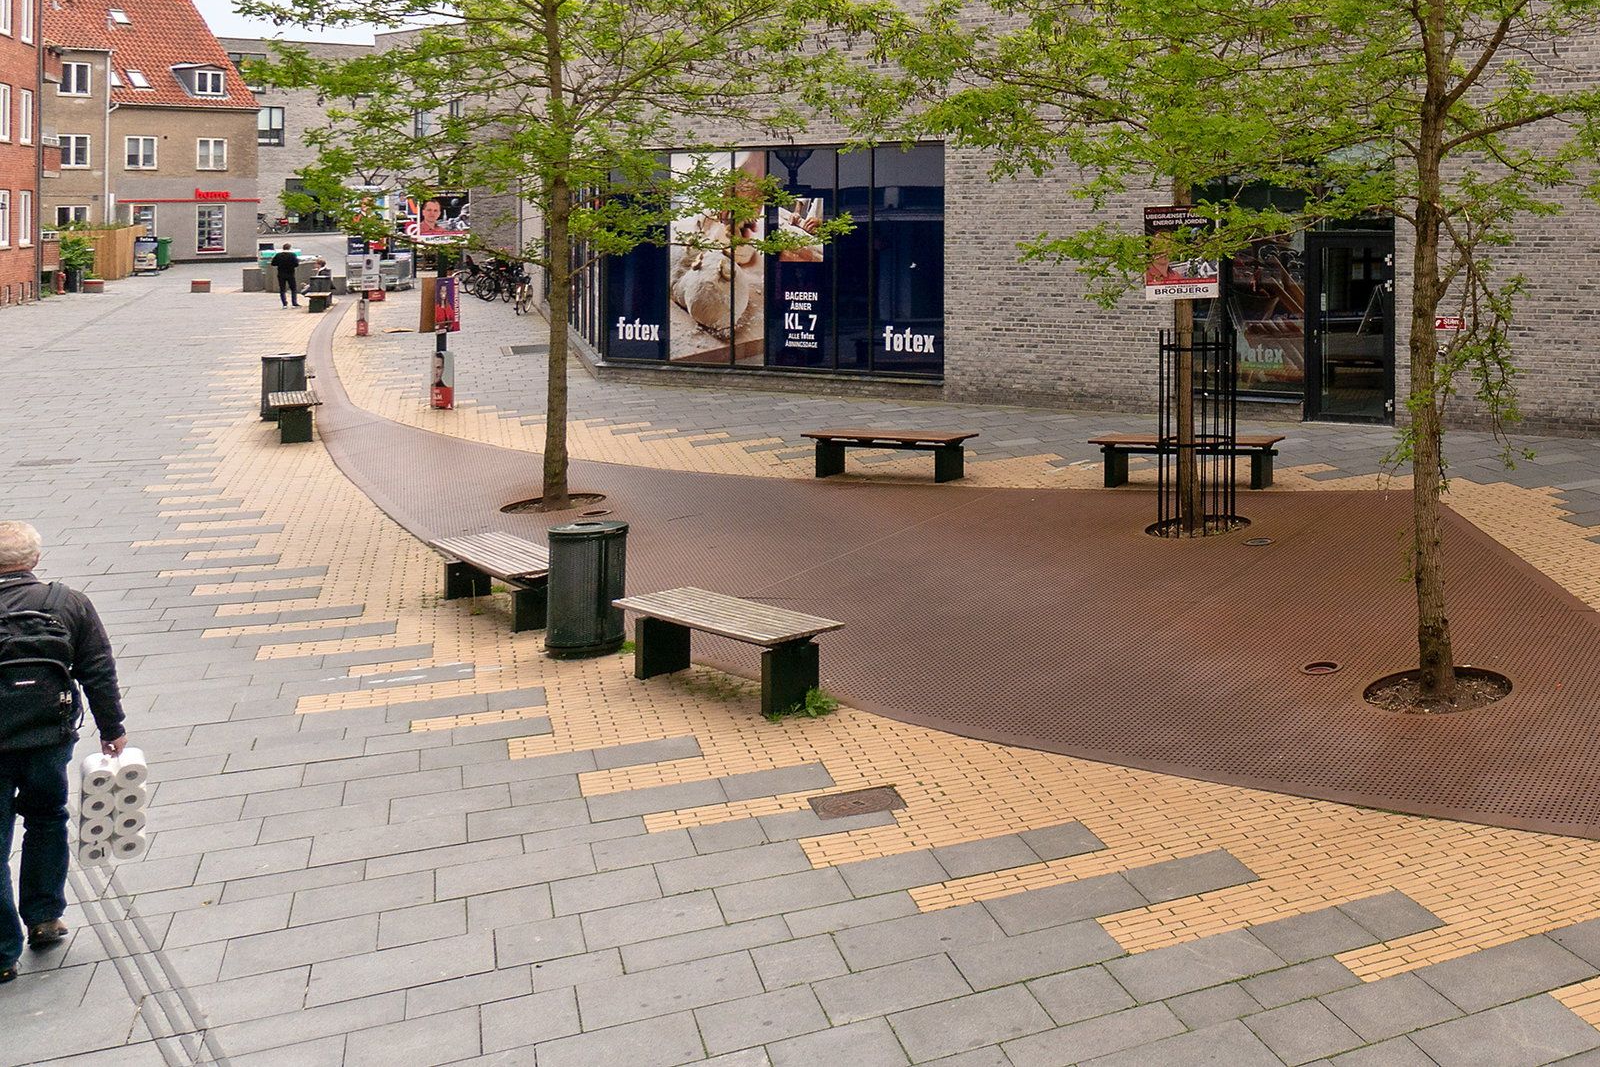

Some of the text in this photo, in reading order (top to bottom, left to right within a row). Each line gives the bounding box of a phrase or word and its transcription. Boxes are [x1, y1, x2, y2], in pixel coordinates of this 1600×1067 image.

[784, 291, 818, 301] BAGEREN
[1154, 286, 1209, 295] BROBJERG
[790, 300, 812, 311] ÅBNER
[616, 316, 660, 341] føtex
[784, 313, 817, 331] KL 7
[882, 325, 935, 353] føtex
